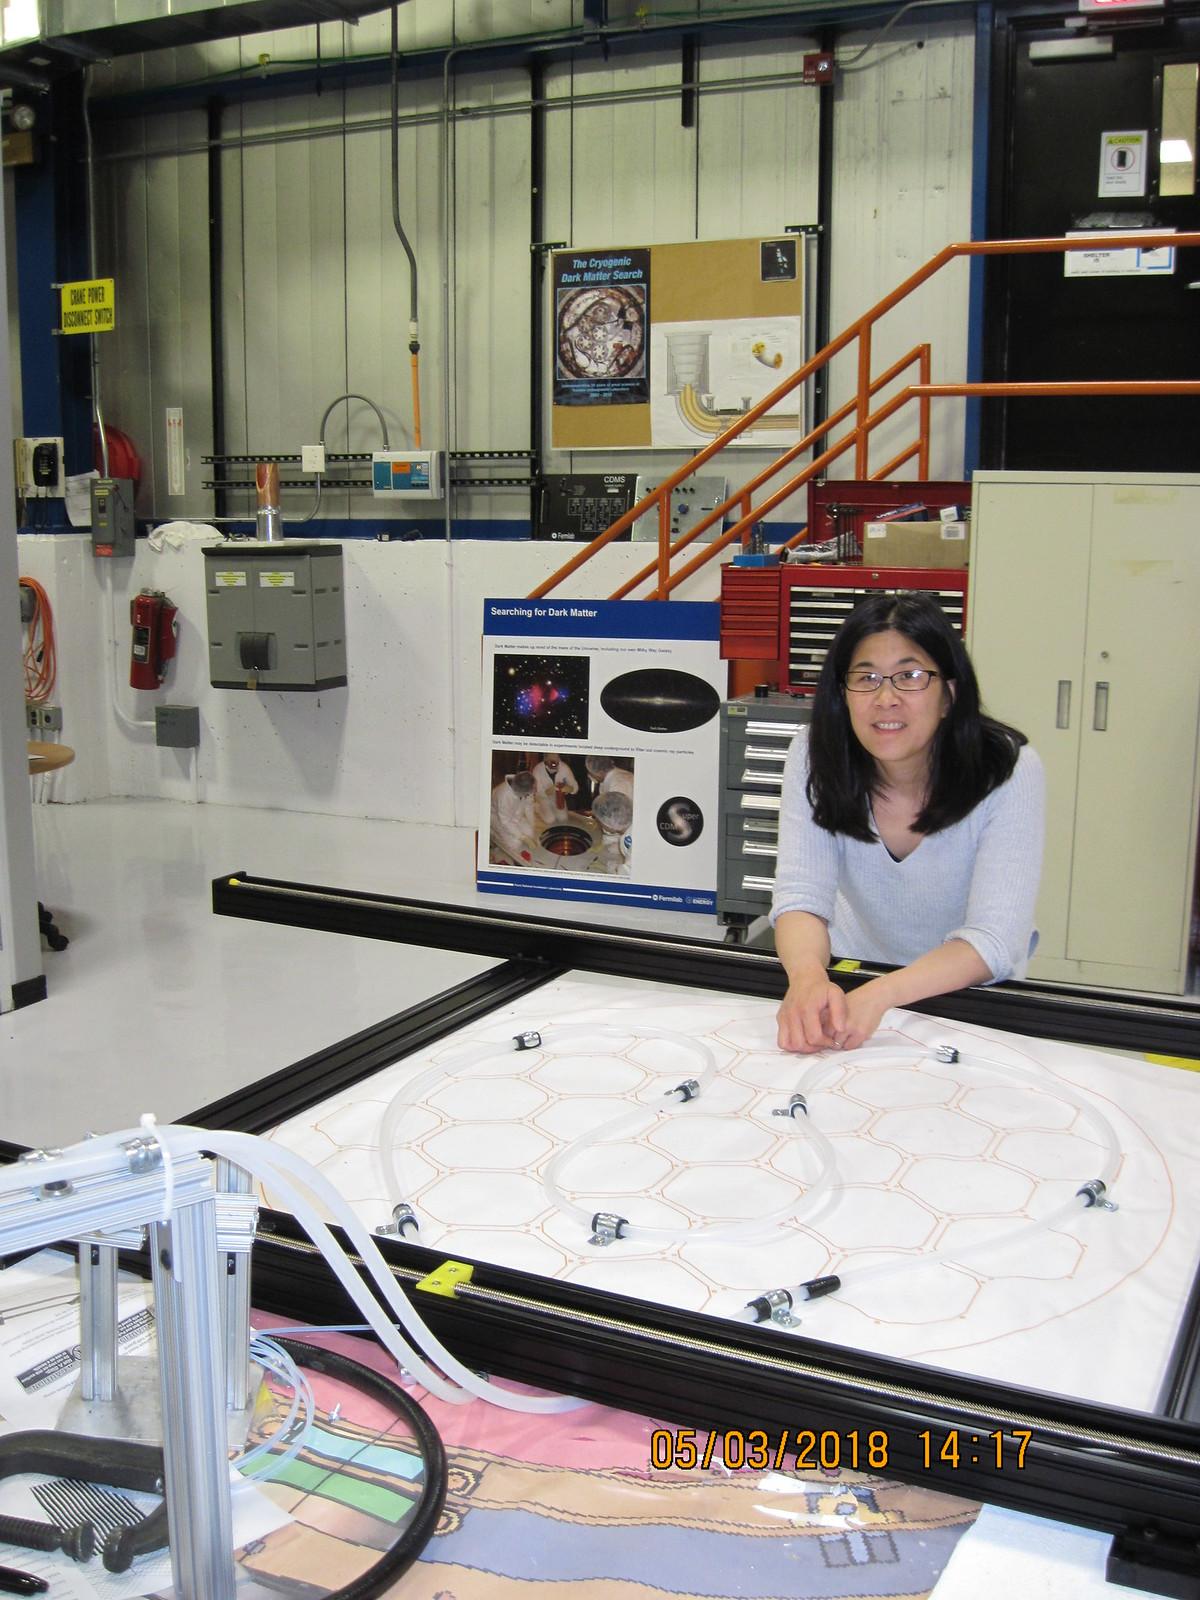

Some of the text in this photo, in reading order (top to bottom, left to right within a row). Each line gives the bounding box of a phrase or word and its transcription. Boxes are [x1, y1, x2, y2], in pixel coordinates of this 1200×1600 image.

[573, 256, 632, 269] The Cryogenic
[561, 269, 643, 283] Dark Matter Search
[70, 286, 105, 306] CRANE POWER
[63, 307, 113, 328] DISCONNECT SWITCH
[603, 475, 626, 484] CDMS
[490, 606, 598, 618] Searching for Dark Matter
[658, 894, 683, 903] Fermilab
